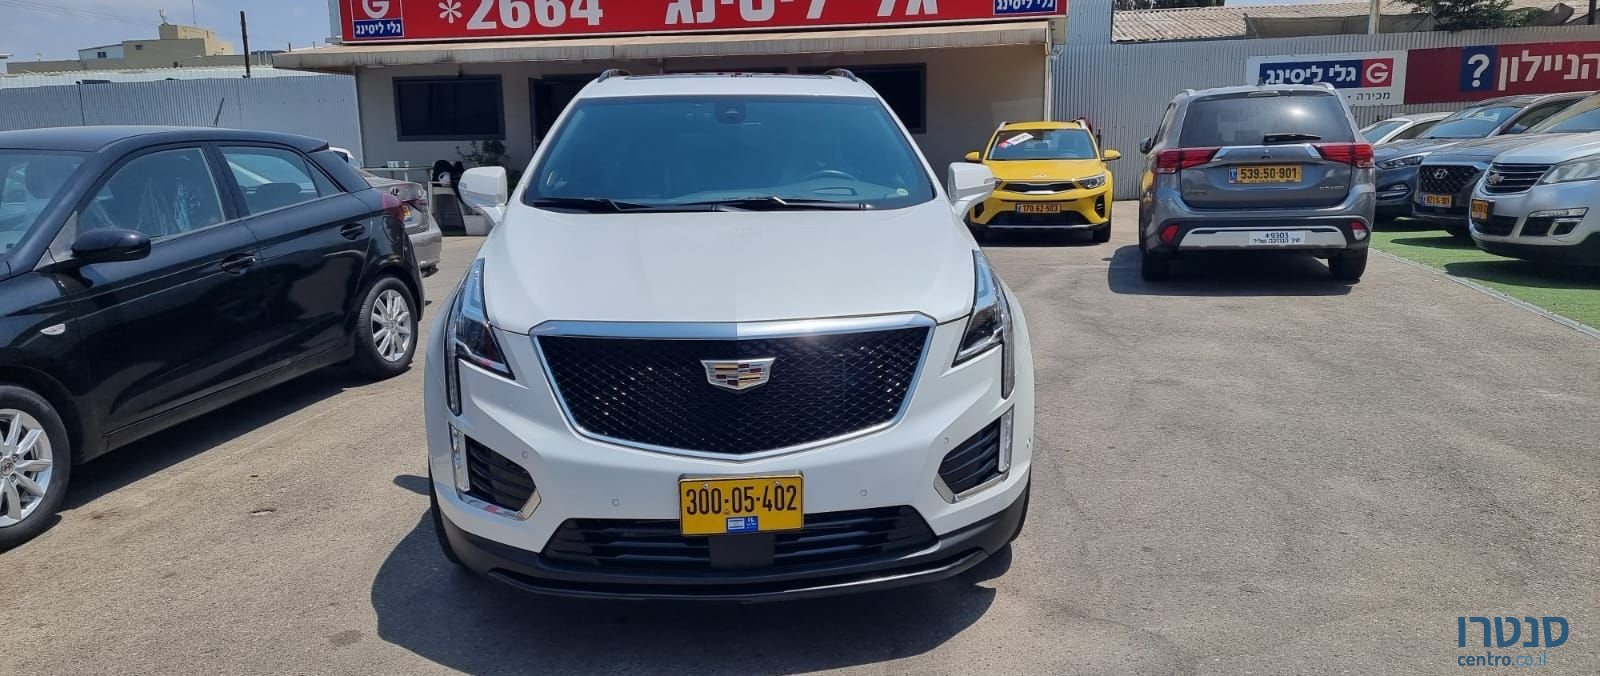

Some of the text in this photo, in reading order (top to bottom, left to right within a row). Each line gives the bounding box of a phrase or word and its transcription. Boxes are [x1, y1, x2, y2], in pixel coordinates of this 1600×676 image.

[356, 21, 401, 35] גלי ליסינג
[1265, 64, 1357, 84] גלי ליסינג
[1365, 62, 1389, 84] G
[1356, 91, 1390, 101] מכירה
[686, 485, 798, 515] 300-05-402
